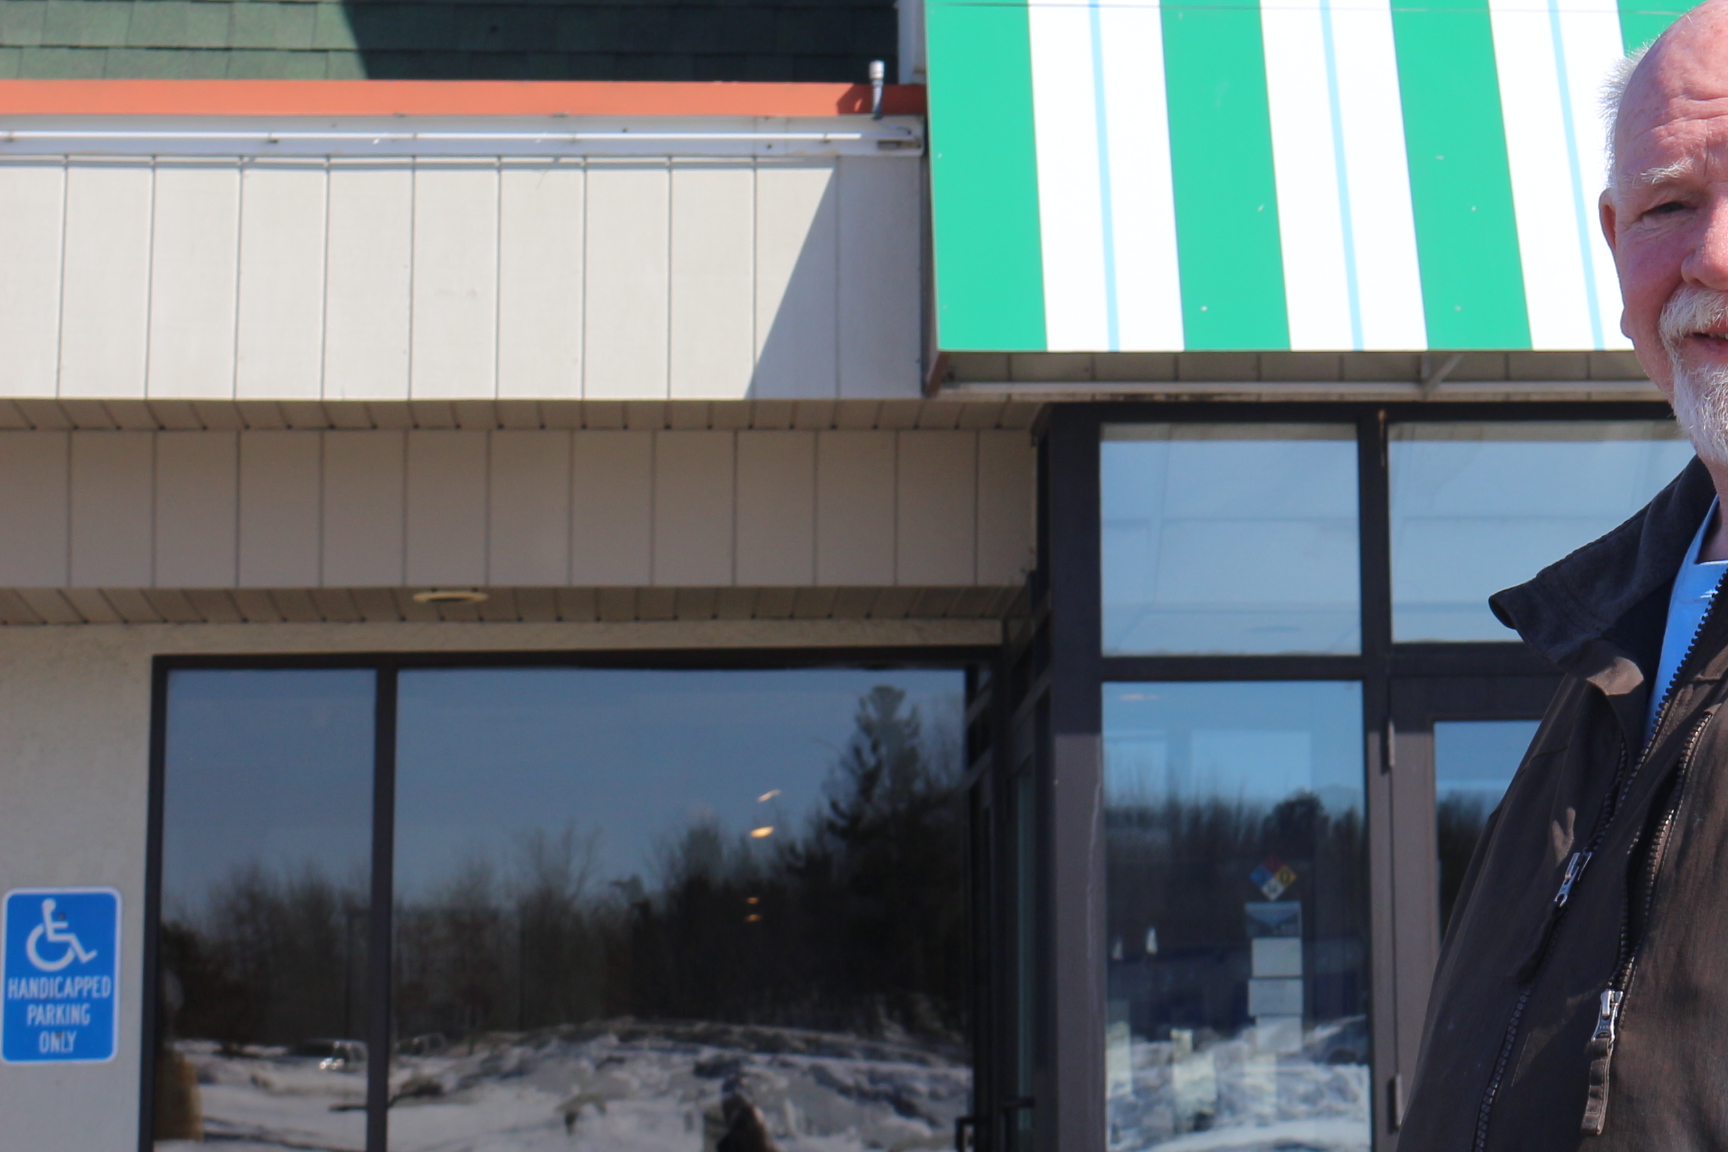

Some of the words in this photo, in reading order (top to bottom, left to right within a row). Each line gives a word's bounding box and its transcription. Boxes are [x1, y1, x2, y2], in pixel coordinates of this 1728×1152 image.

[8, 975, 112, 999] HANDICAPPED
[27, 1003, 91, 1026] PARKING
[38, 1030, 77, 1053] ONLY
